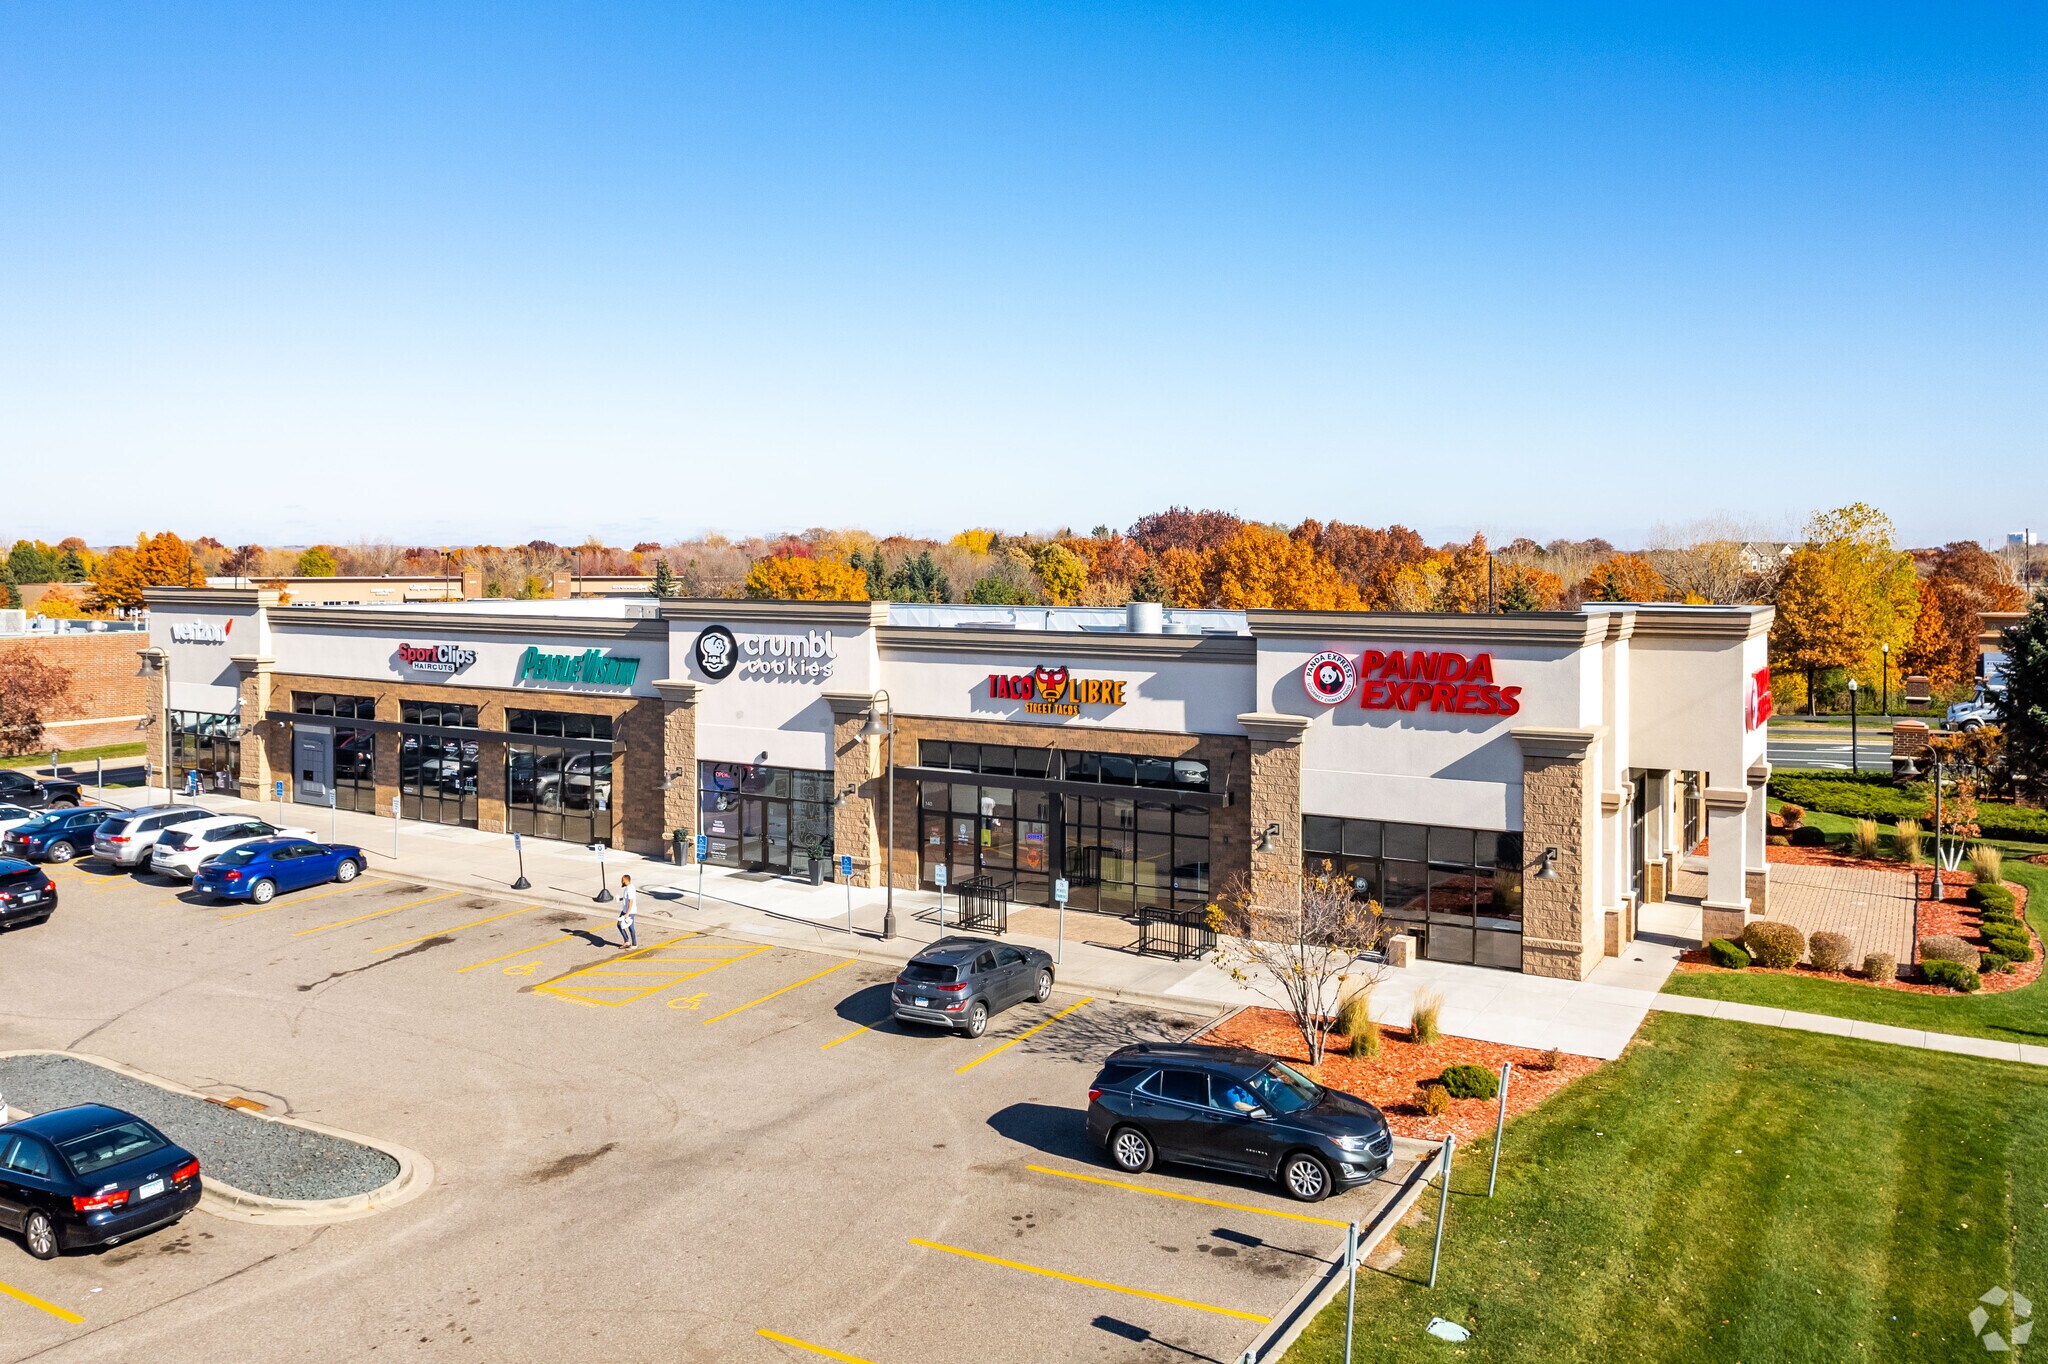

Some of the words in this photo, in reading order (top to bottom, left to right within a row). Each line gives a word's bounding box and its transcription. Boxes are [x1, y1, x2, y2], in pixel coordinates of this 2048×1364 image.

[172, 618, 228, 642] verizon
[744, 629, 837, 659] crumbl
[414, 663, 454, 671] HAIRCUTS
[521, 646, 583, 682] PEARLE
[747, 658, 834, 677] cookies
[1306, 655, 1325, 677] PANDA
[1327, 653, 1352, 678] EXPRESS
[1360, 650, 1495, 684] PANDA
[988, 674, 1035, 701] TACO
[1069, 678, 1128, 706] LIBRE
[1360, 680, 1523, 717] EXPRESS
[1024, 702, 1051, 714] STREET
[1054, 704, 1080, 716] TACOS
